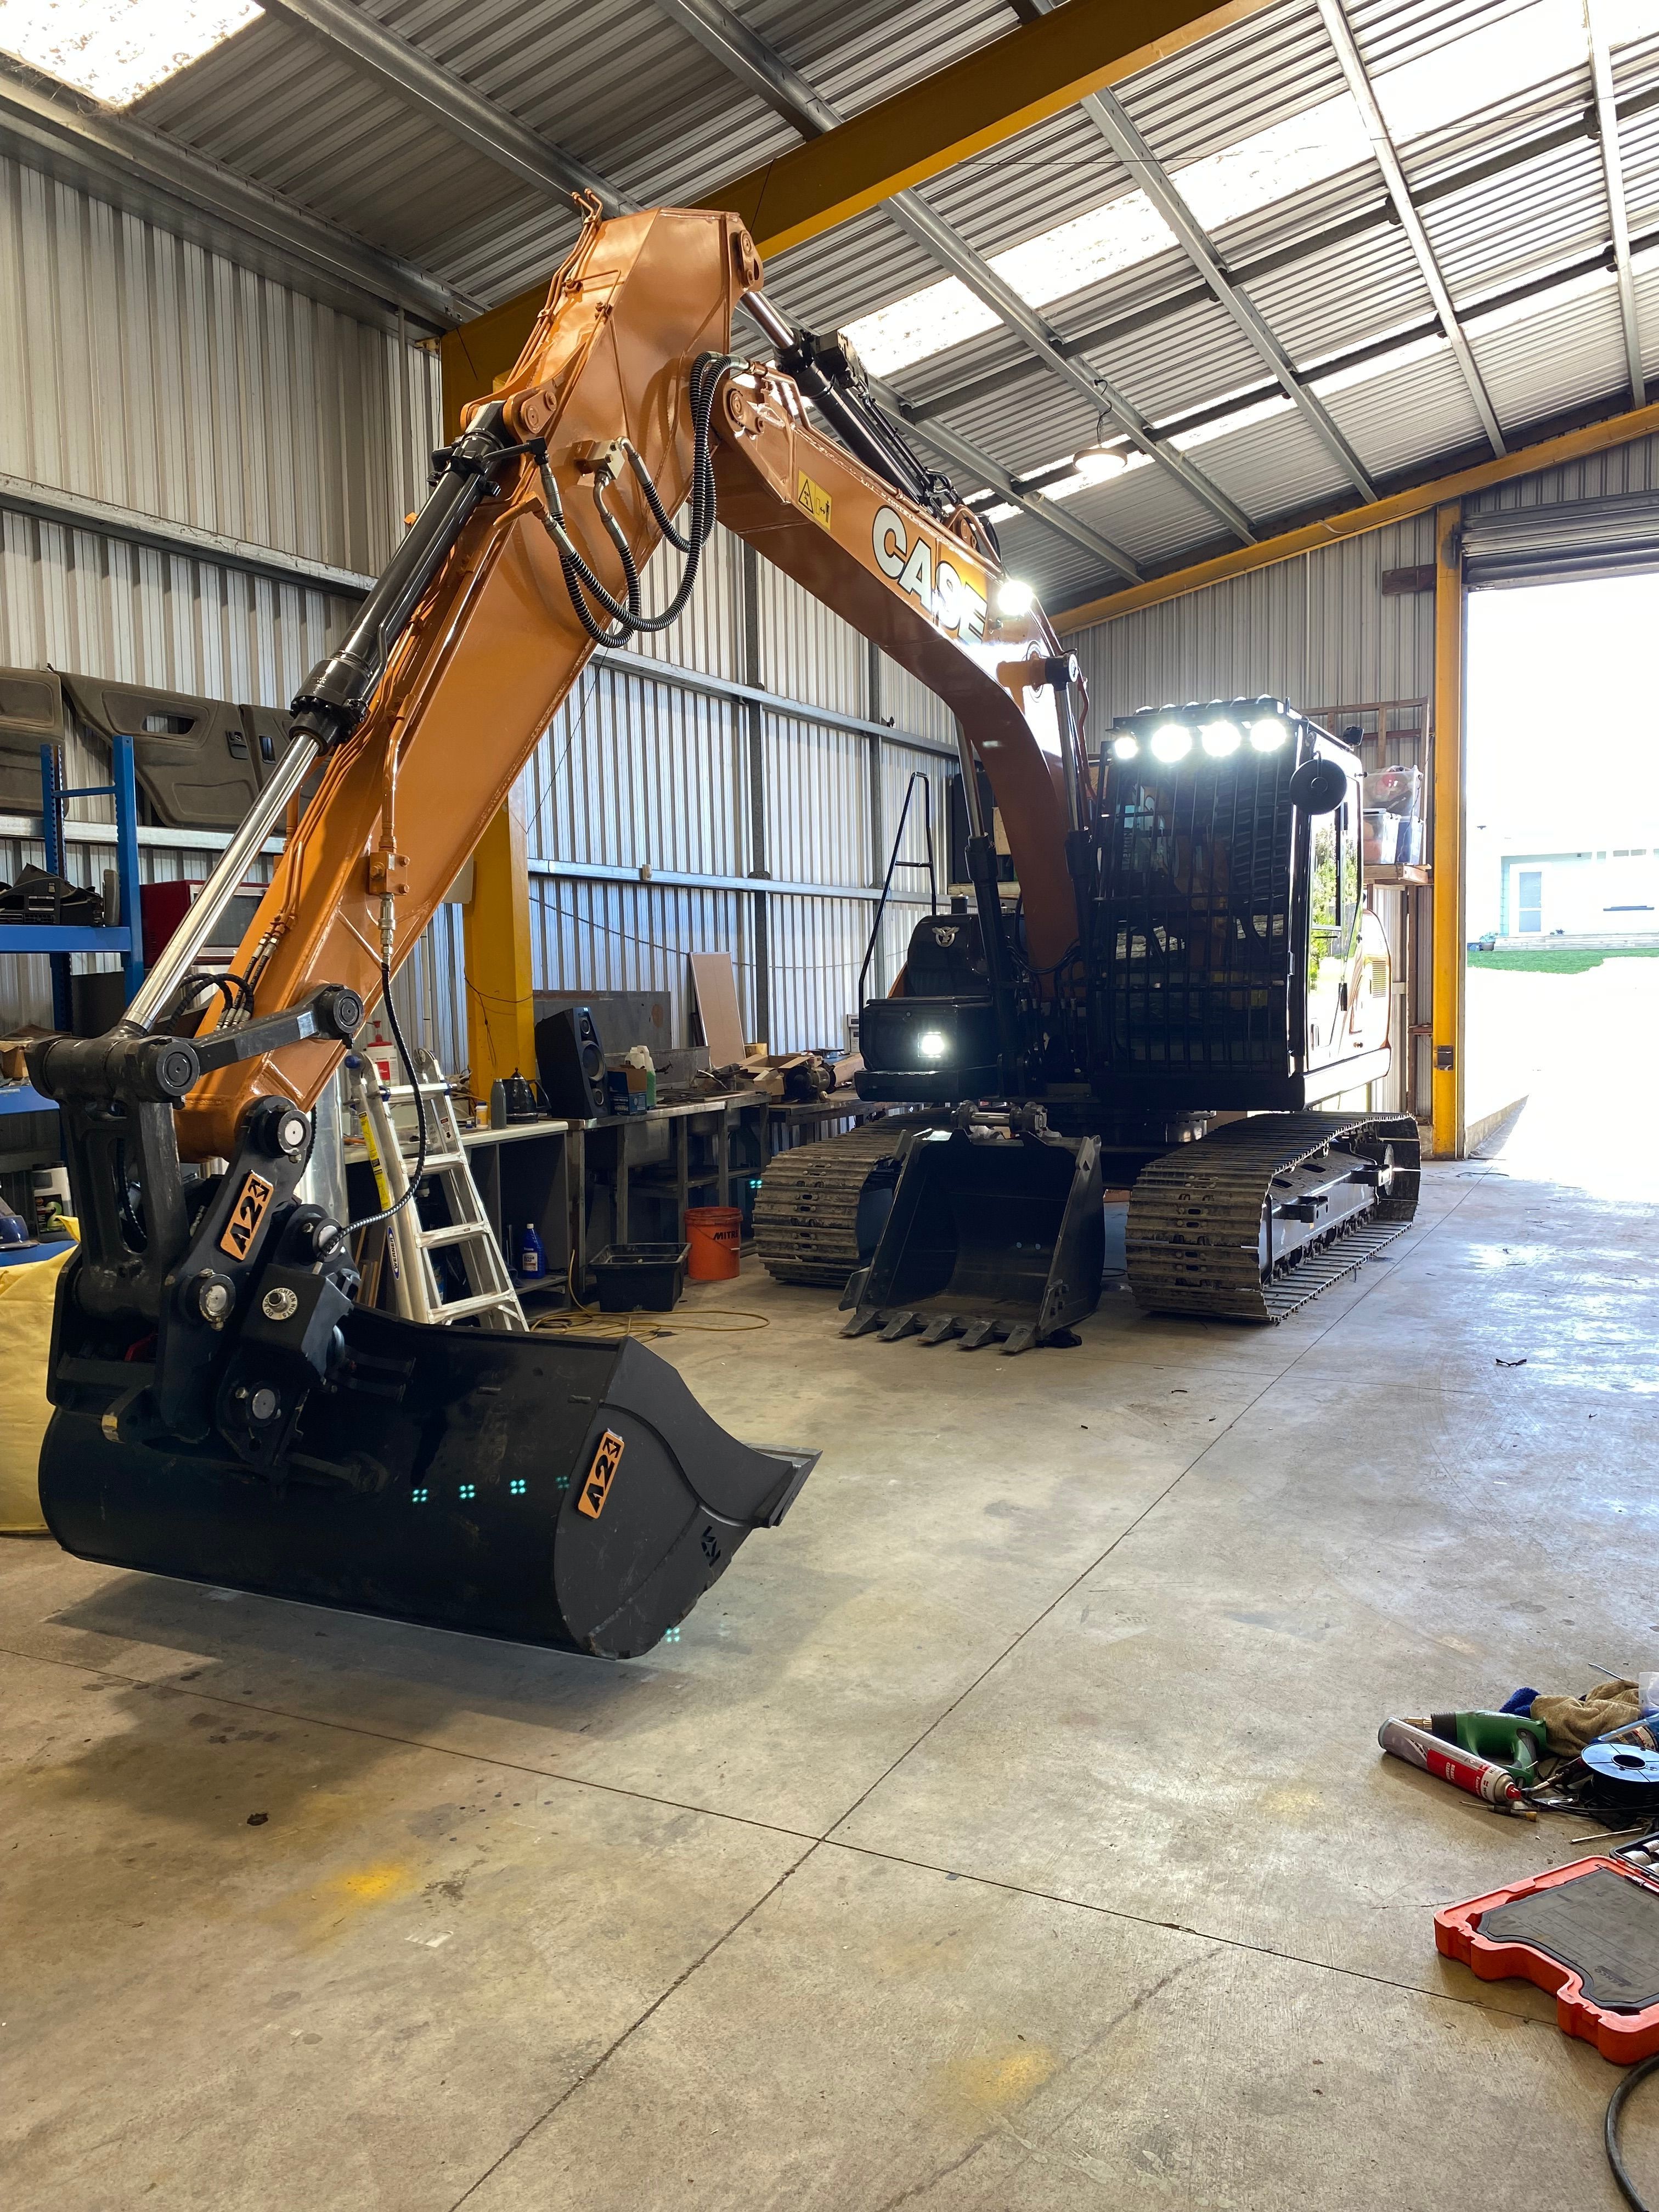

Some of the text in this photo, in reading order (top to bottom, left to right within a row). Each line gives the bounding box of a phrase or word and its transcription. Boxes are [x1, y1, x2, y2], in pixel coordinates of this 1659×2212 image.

[872, 504, 988, 645] CASE
[390, 1237, 398, 1269] WERNER
[266, 1308, 274, 1317] DO
[282, 1304, 297, 1318] NUTS
